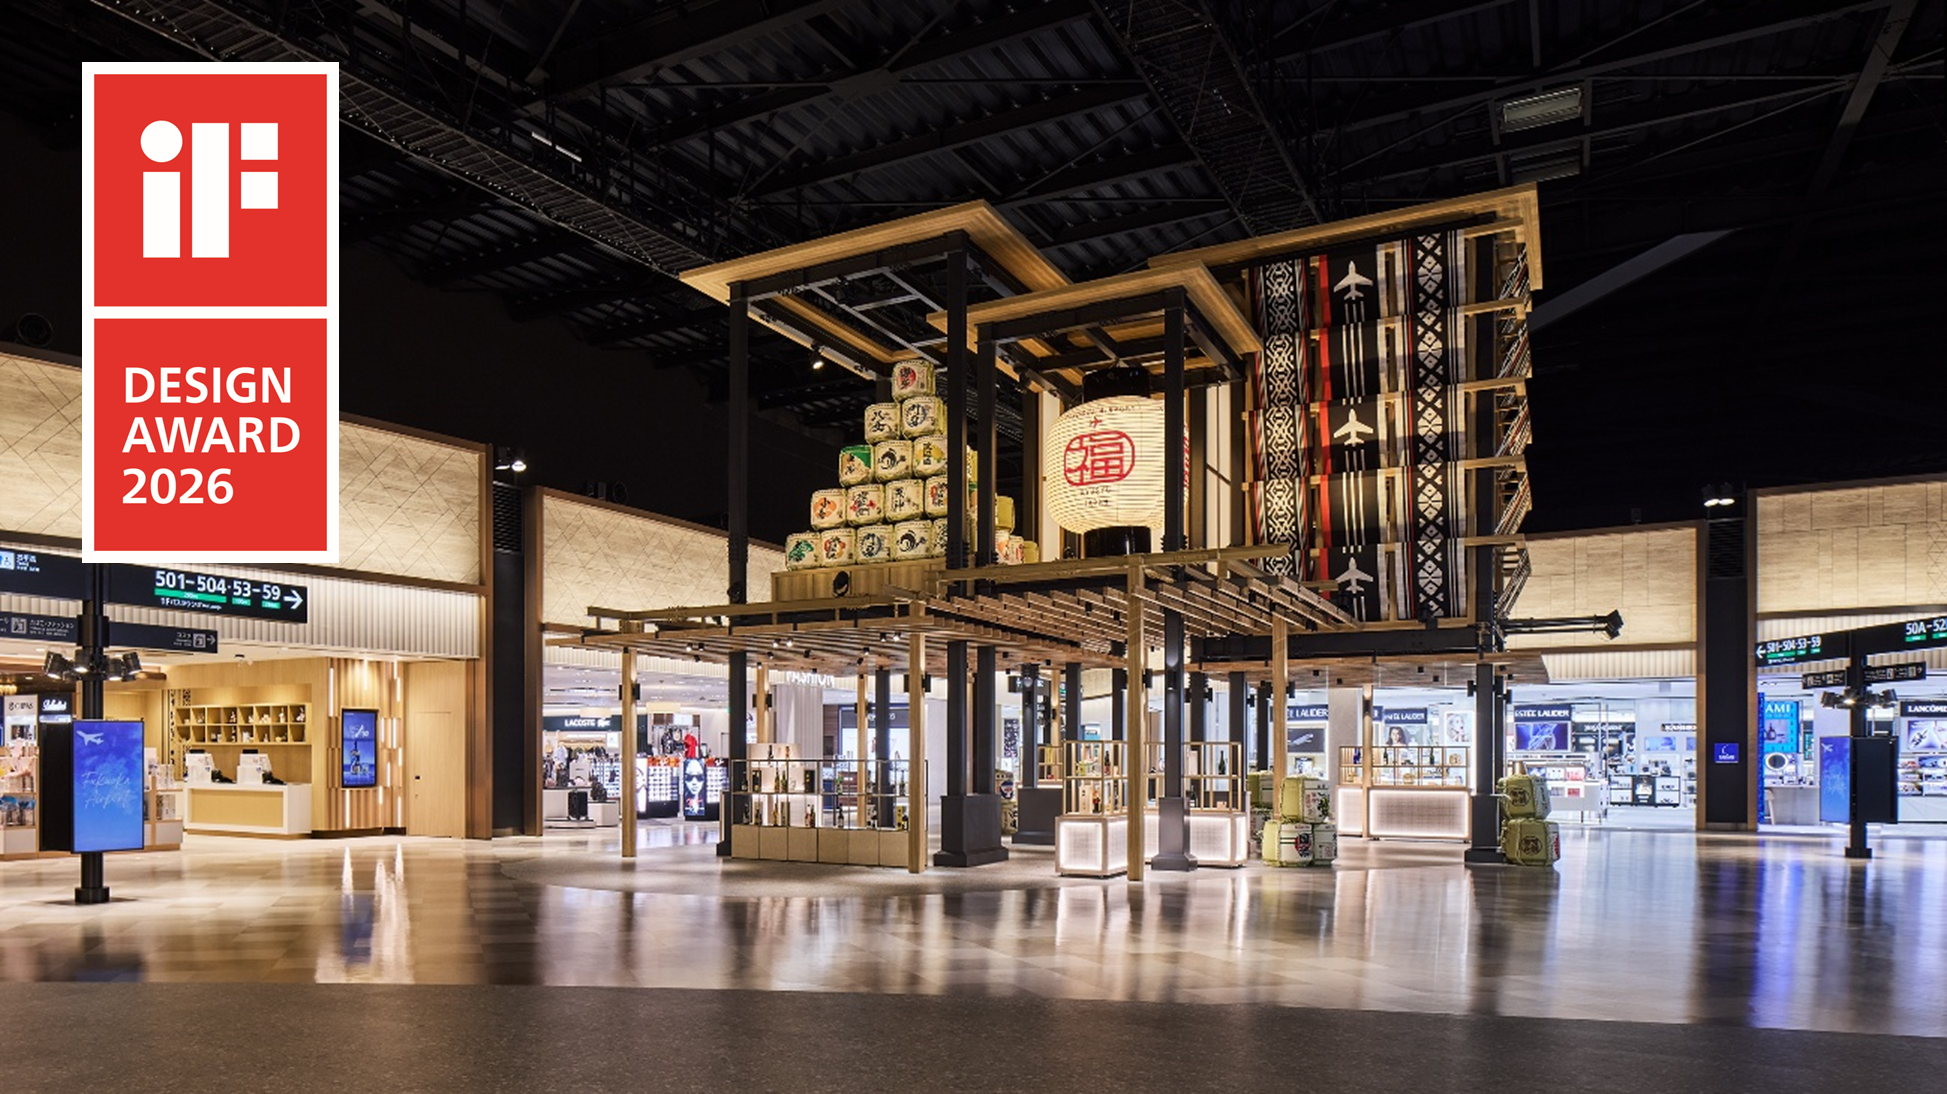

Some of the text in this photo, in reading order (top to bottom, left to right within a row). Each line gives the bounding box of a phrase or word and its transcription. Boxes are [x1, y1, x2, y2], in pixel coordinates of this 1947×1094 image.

[1063, 430, 1136, 487] 福
[1537, 709, 1570, 718] LAUDER
[564, 718, 595, 727] LACOSTE
